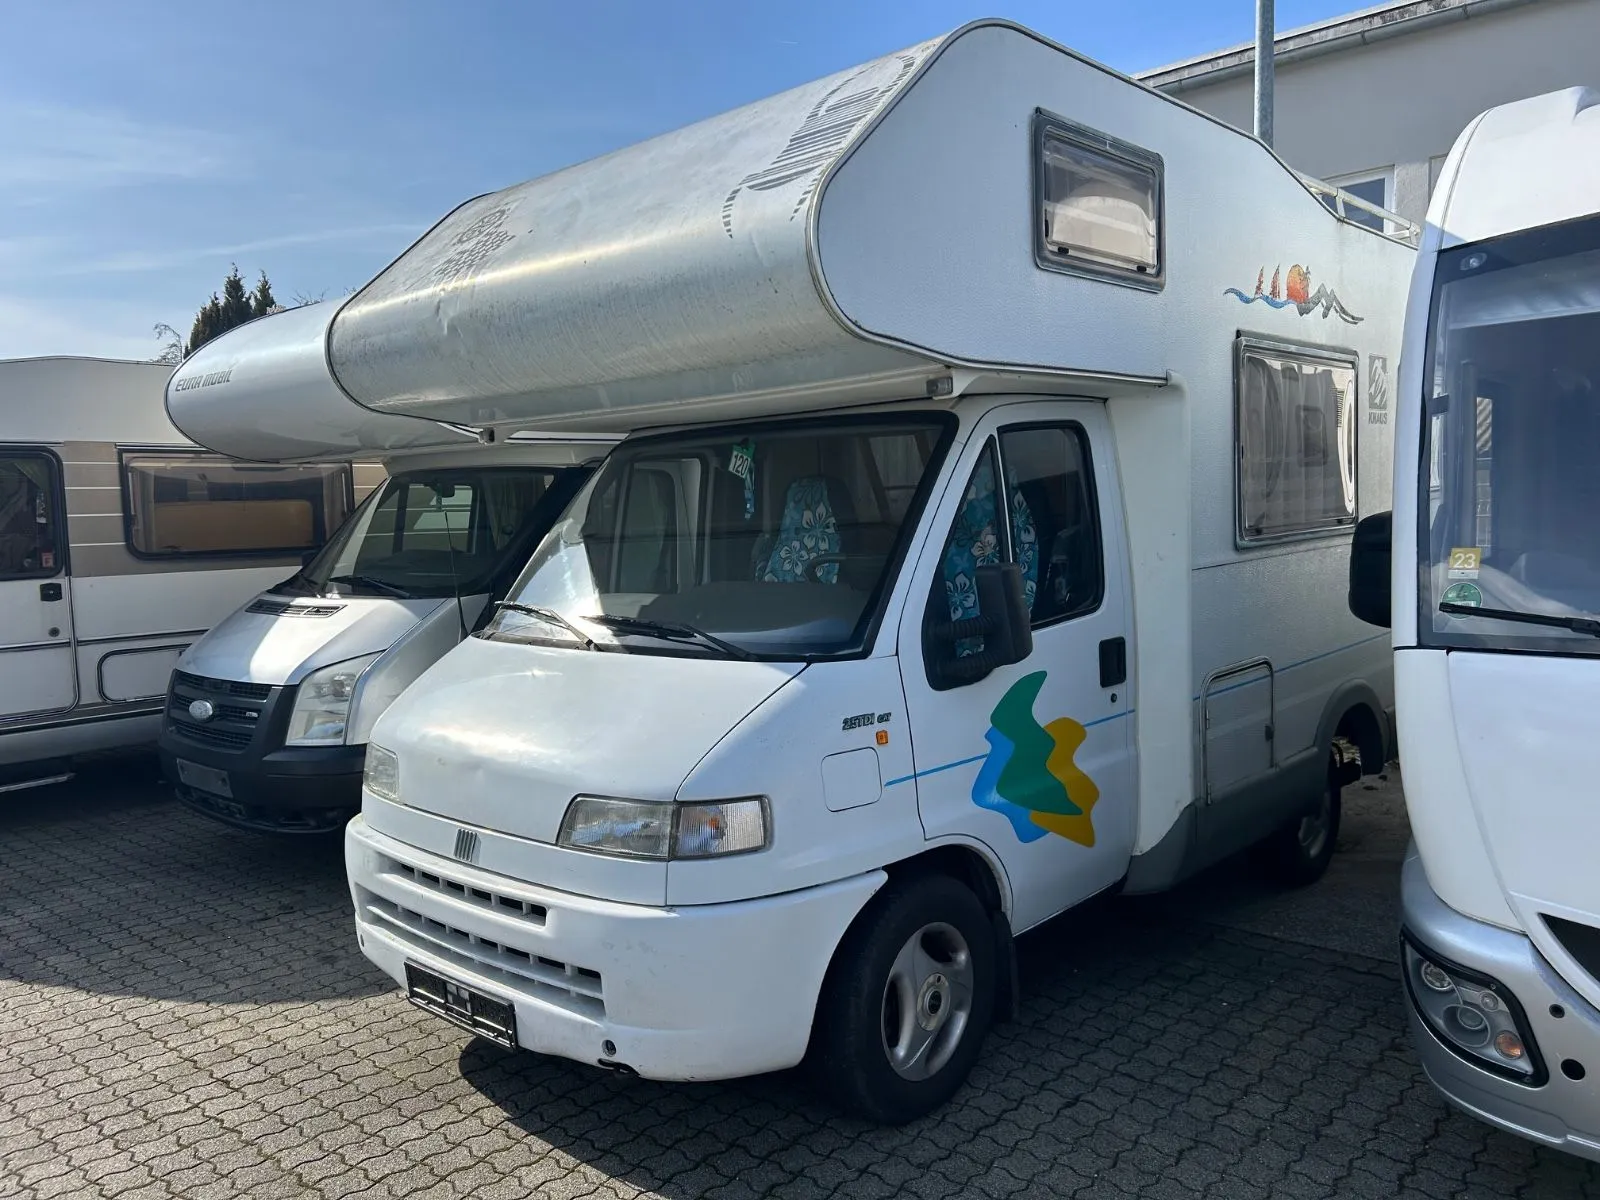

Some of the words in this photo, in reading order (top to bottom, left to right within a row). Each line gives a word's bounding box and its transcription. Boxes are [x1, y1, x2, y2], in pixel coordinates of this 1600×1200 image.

[175, 375, 203, 392] EURA
[201, 369, 233, 388] MOBIL
[1368, 411, 1388, 425] KNAUS
[732, 453, 749, 476] 120
[1453, 553, 1476, 569] 23
